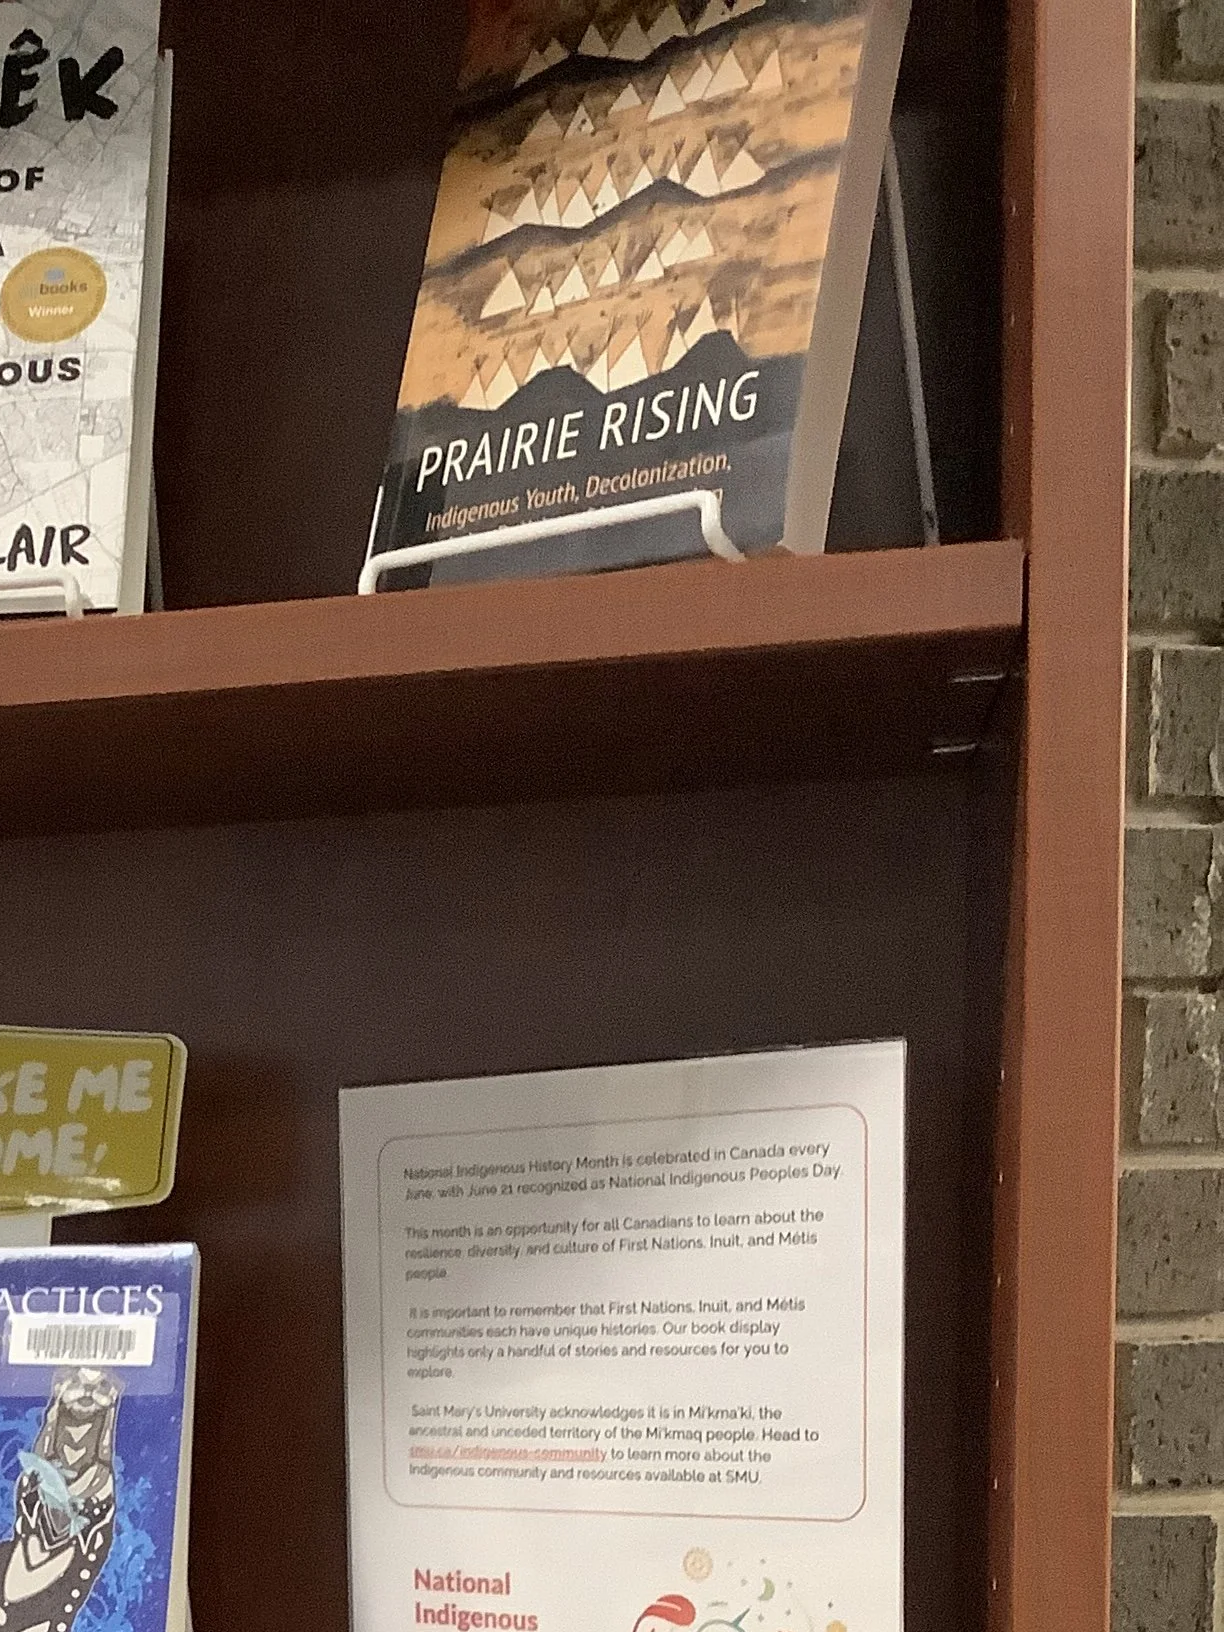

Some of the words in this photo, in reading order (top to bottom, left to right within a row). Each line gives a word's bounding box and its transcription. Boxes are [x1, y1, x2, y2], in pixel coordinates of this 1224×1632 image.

[28, 304, 74, 318] Winner
[416, 411, 584, 493] PRAIRIE
[599, 370, 759, 450] RISING
[426, 495, 519, 532] Indigenous
[526, 482, 579, 509] Youth,
[585, 453, 731, 499] Decolonization,
[67, 1060, 153, 1113] ME
[404, 1165, 453, 1180] National
[457, 1163, 525, 1179] Indigenous
[529, 1160, 573, 1174] History
[576, 1155, 619, 1169] Month
[622, 1154, 633, 1167] is
[636, 1148, 710, 1166] celebrated
[714, 1149, 726, 1161] in
[730, 1144, 785, 1160] Canada
[789, 1143, 830, 1158] every
[405, 1226, 428, 1239] This
[432, 1225, 470, 1238] month
[474, 1226, 484, 1237] is
[487, 1226, 501, 1237] an
[505, 1220, 578, 1237] opportunity
[582, 1218, 599, 1232] for
[603, 1217, 619, 1231] all
[623, 1215, 693, 1231] Canadians
[697, 1215, 710, 1228] to
[714, 1213, 750, 1227] learn
[755, 1210, 796, 1225] about
[800, 1208, 824, 1222] the
[414, 1568, 511, 1595] National
[415, 1601, 538, 1632] Indigenous
